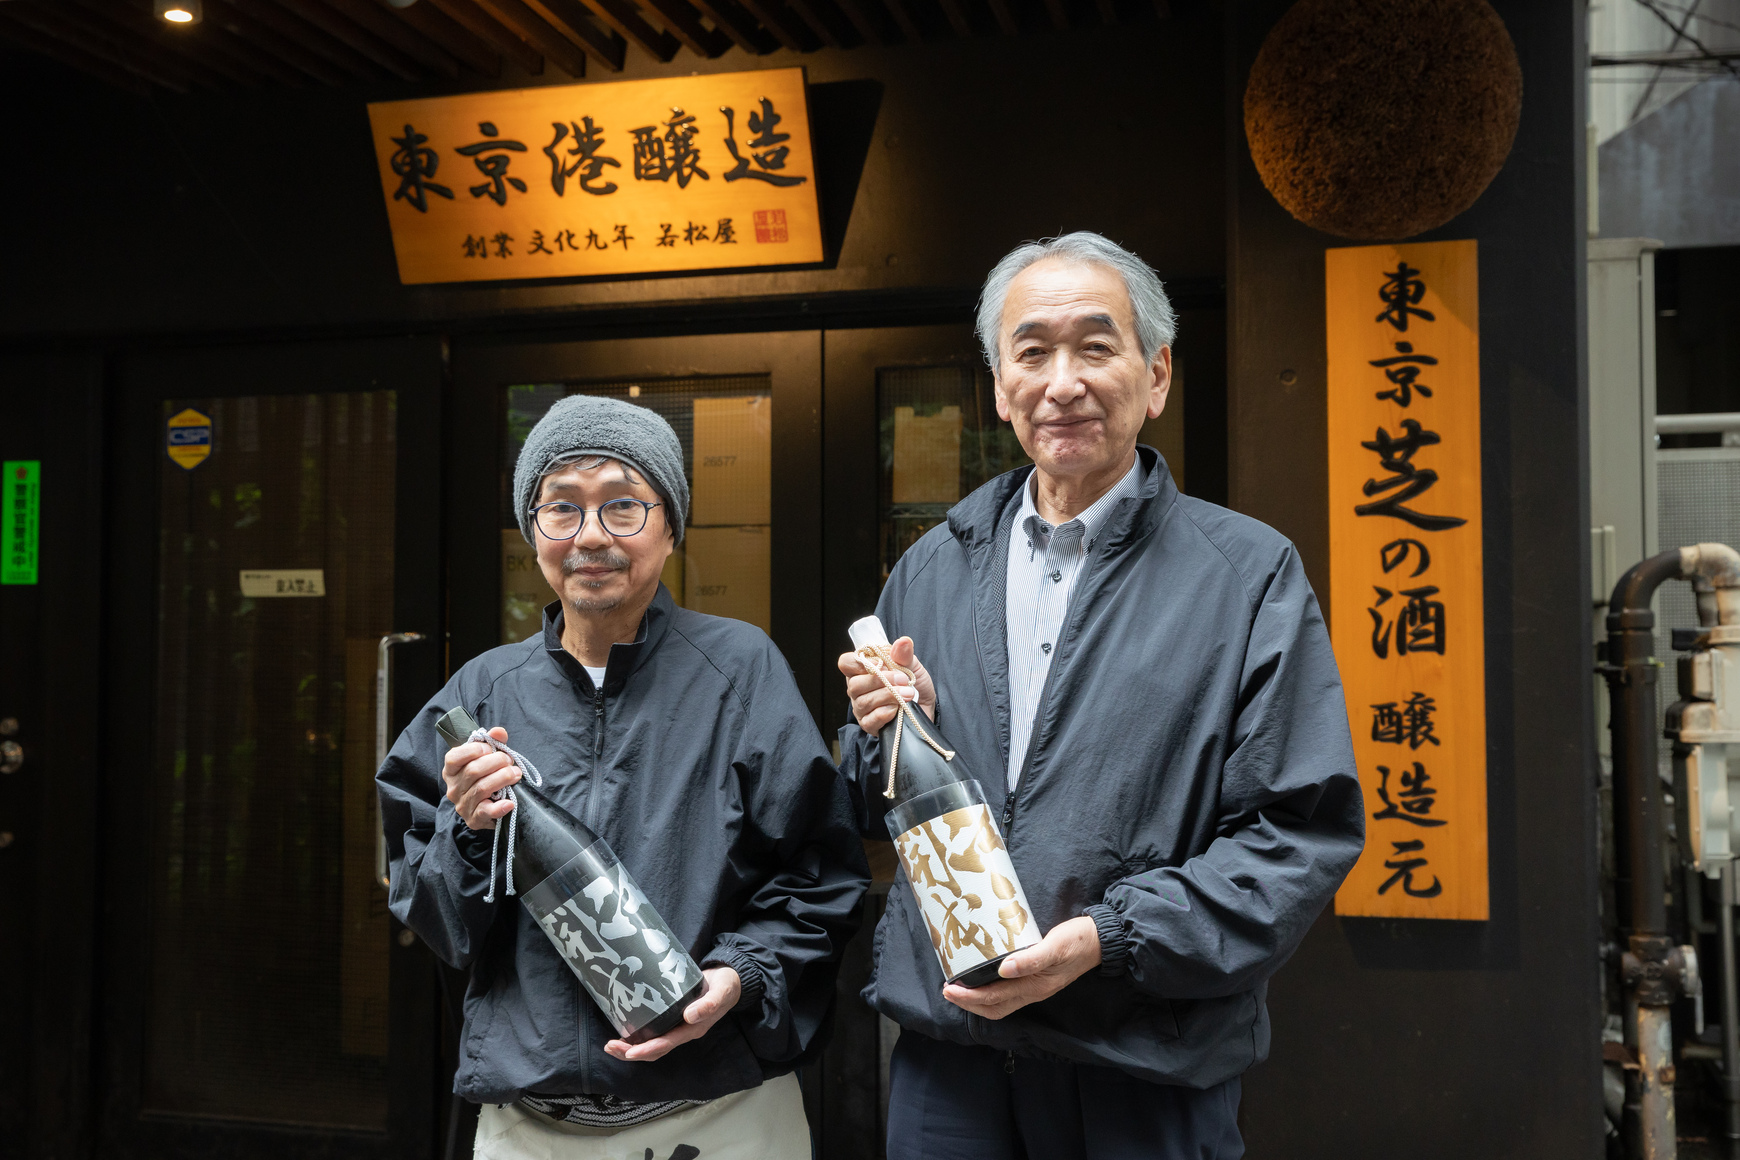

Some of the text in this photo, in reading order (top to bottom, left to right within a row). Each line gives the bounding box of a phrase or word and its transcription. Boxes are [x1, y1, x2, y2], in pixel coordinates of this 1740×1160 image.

[391, 96, 806, 213] 東京港醸造
[462, 232, 514, 259] 創業
[527, 224, 634, 254] 文化九年
[656, 218, 738, 247] 若松屋
[703, 455, 737, 467] 26577
[1354, 262, 1468, 898] 東京芝の酒 醸造元
